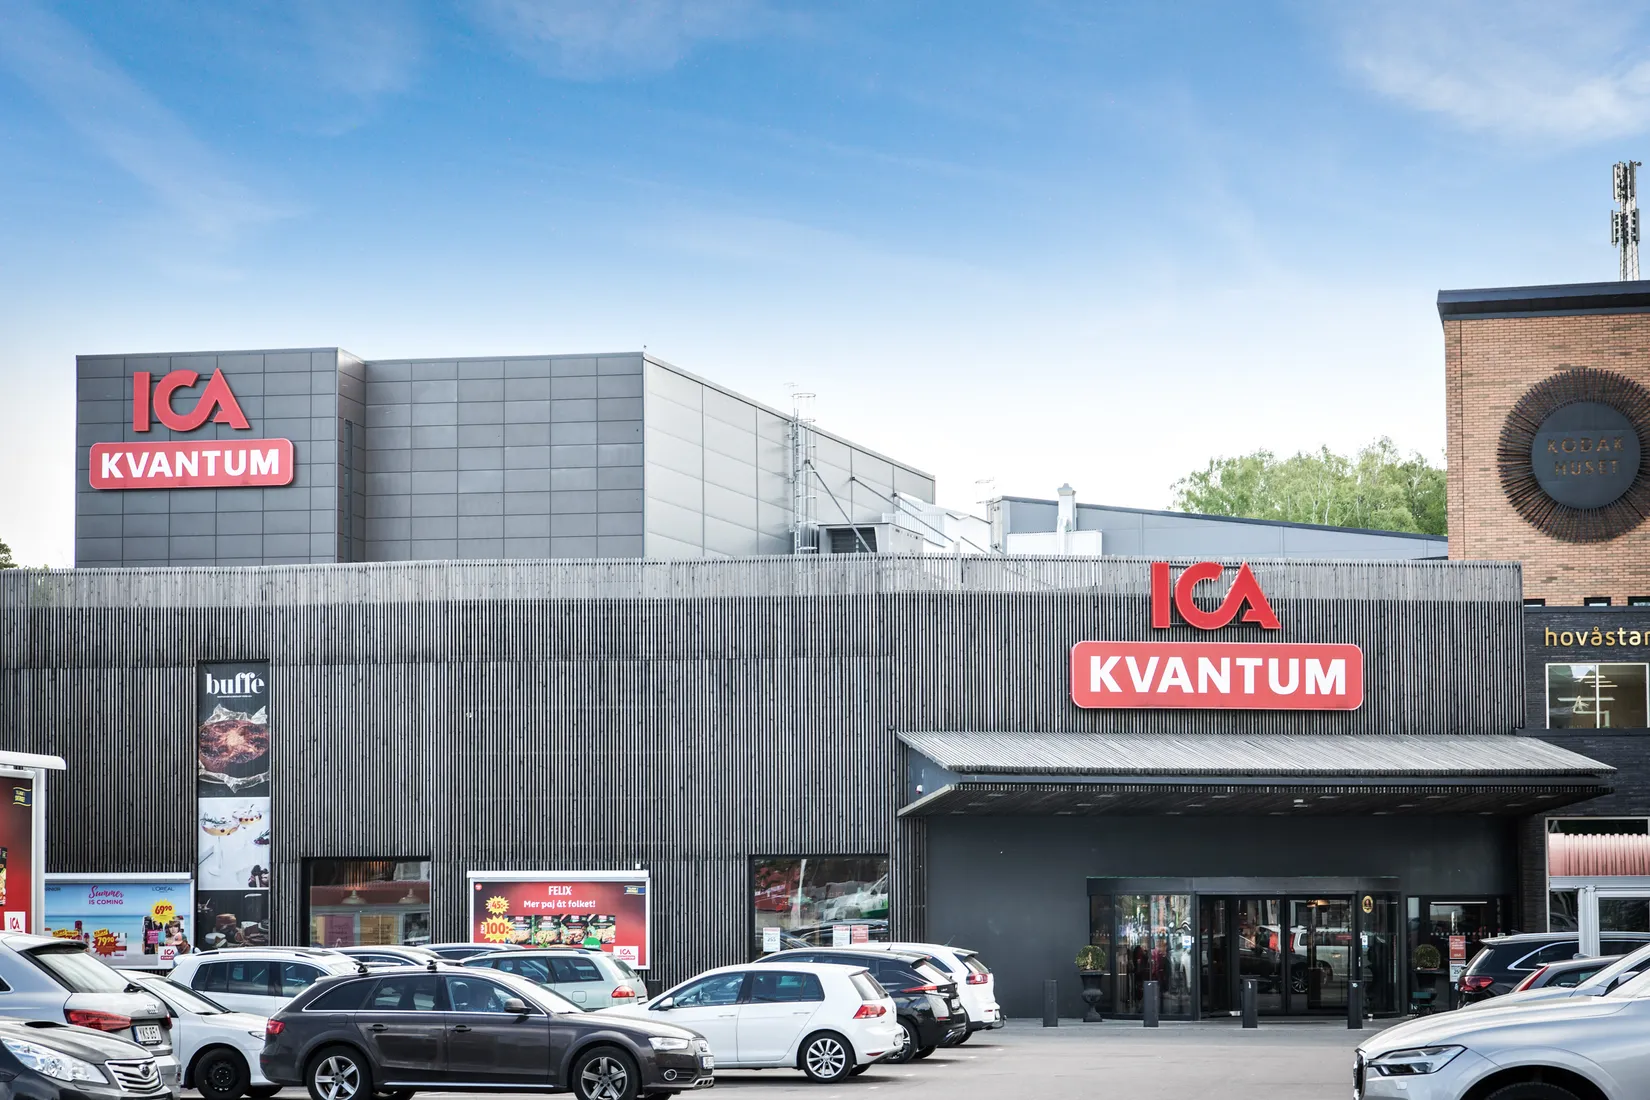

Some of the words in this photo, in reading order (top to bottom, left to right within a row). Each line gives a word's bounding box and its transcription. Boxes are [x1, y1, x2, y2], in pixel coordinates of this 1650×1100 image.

[132, 367, 250, 432] ICA
[1547, 436, 1624, 454] KODAK
[101, 448, 279, 479] KVANTUM
[1151, 561, 1282, 630] ICA
[205, 671, 265, 695] buffé
[1090, 655, 1346, 695] KVANTUM
[88, 885, 124, 899] Summer
[548, 886, 572, 896] FELIX
[523, 900, 540, 908] Mer
[541, 900, 556, 909] paj
[556, 900, 567, 908] åt
[567, 900, 596, 908] folket!
[9, 917, 20, 930] ICA
[486, 922, 513, 935] 100:-
